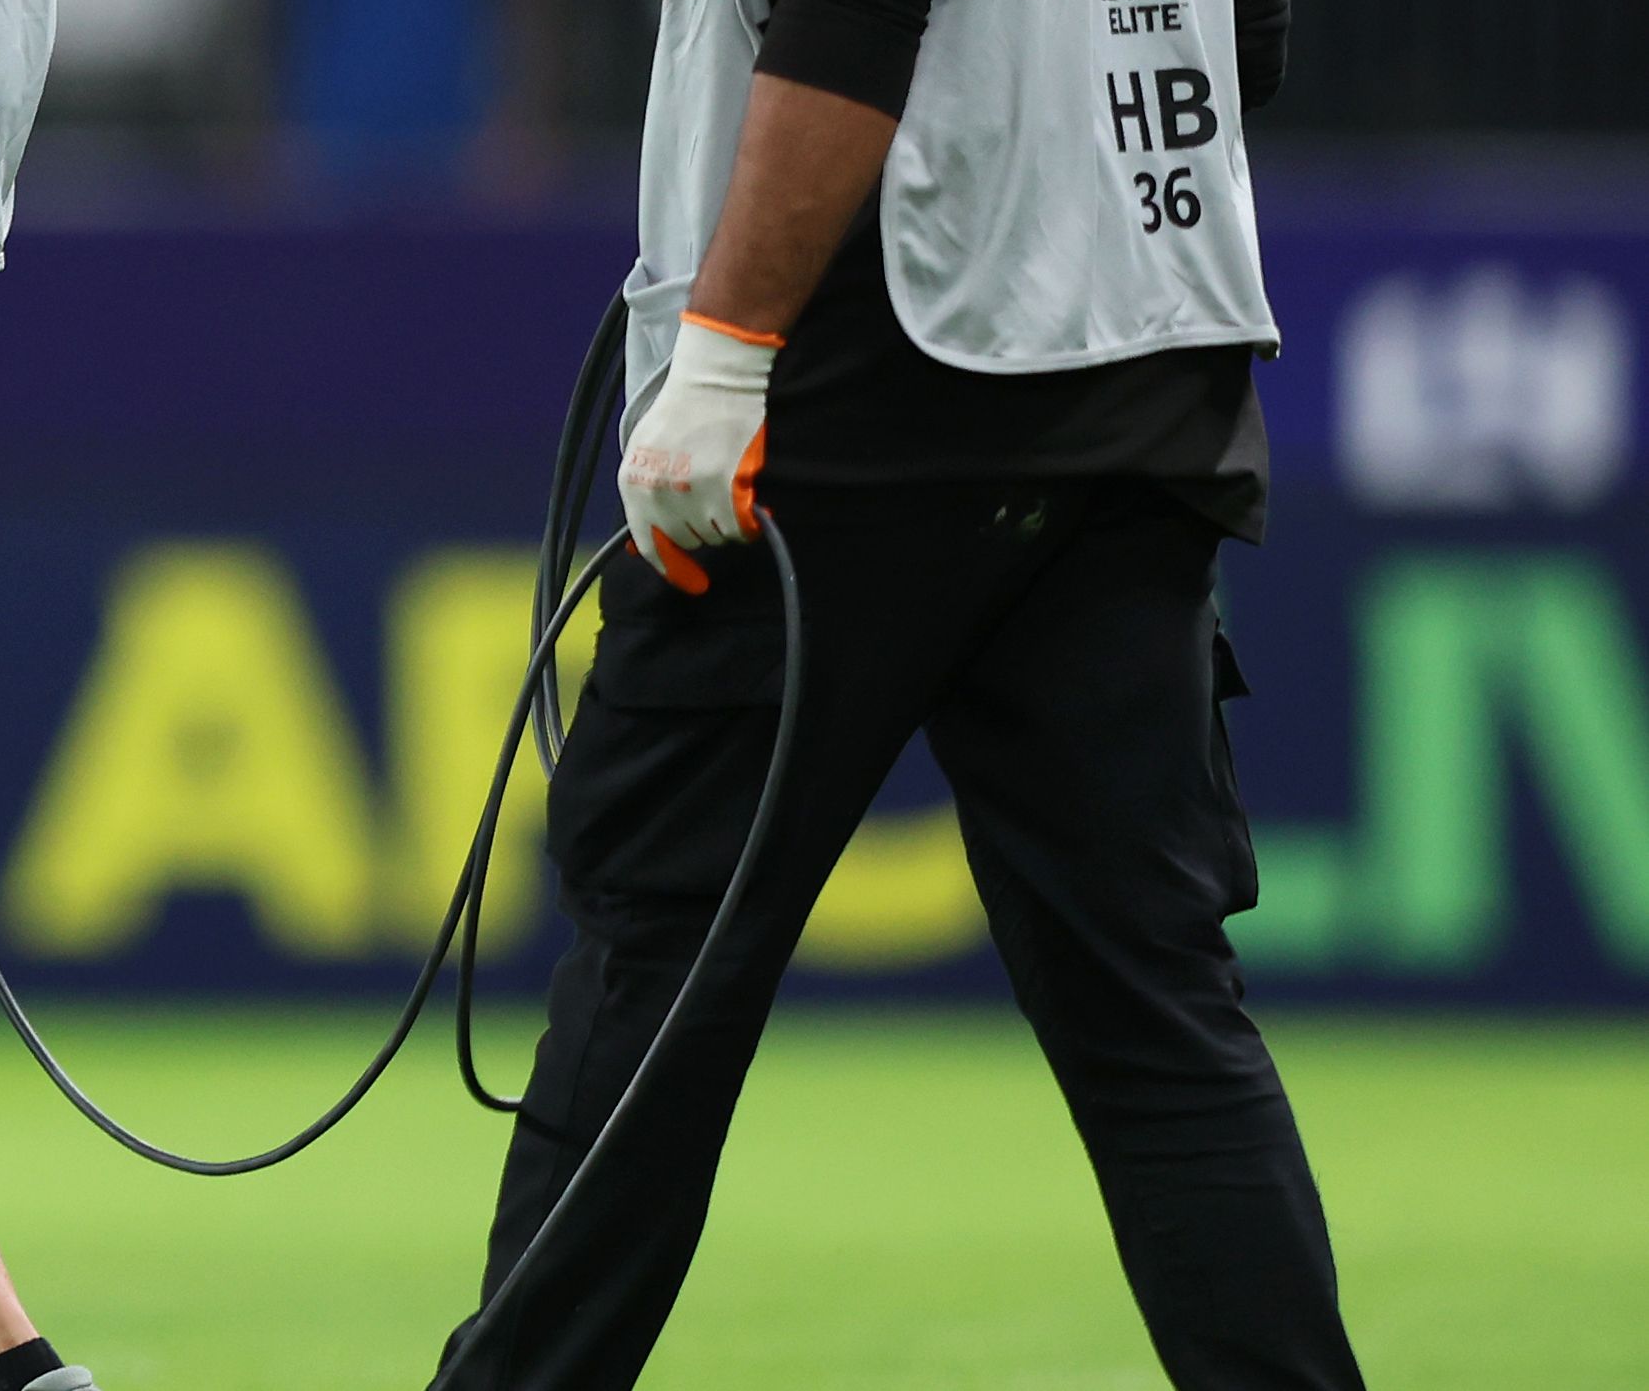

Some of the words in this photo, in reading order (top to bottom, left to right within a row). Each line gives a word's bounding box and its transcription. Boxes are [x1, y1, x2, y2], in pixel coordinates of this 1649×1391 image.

[1108, 3, 1182, 35] ELITE
[1106, 67, 1218, 153] HB
[1133, 166, 1201, 235] 36
